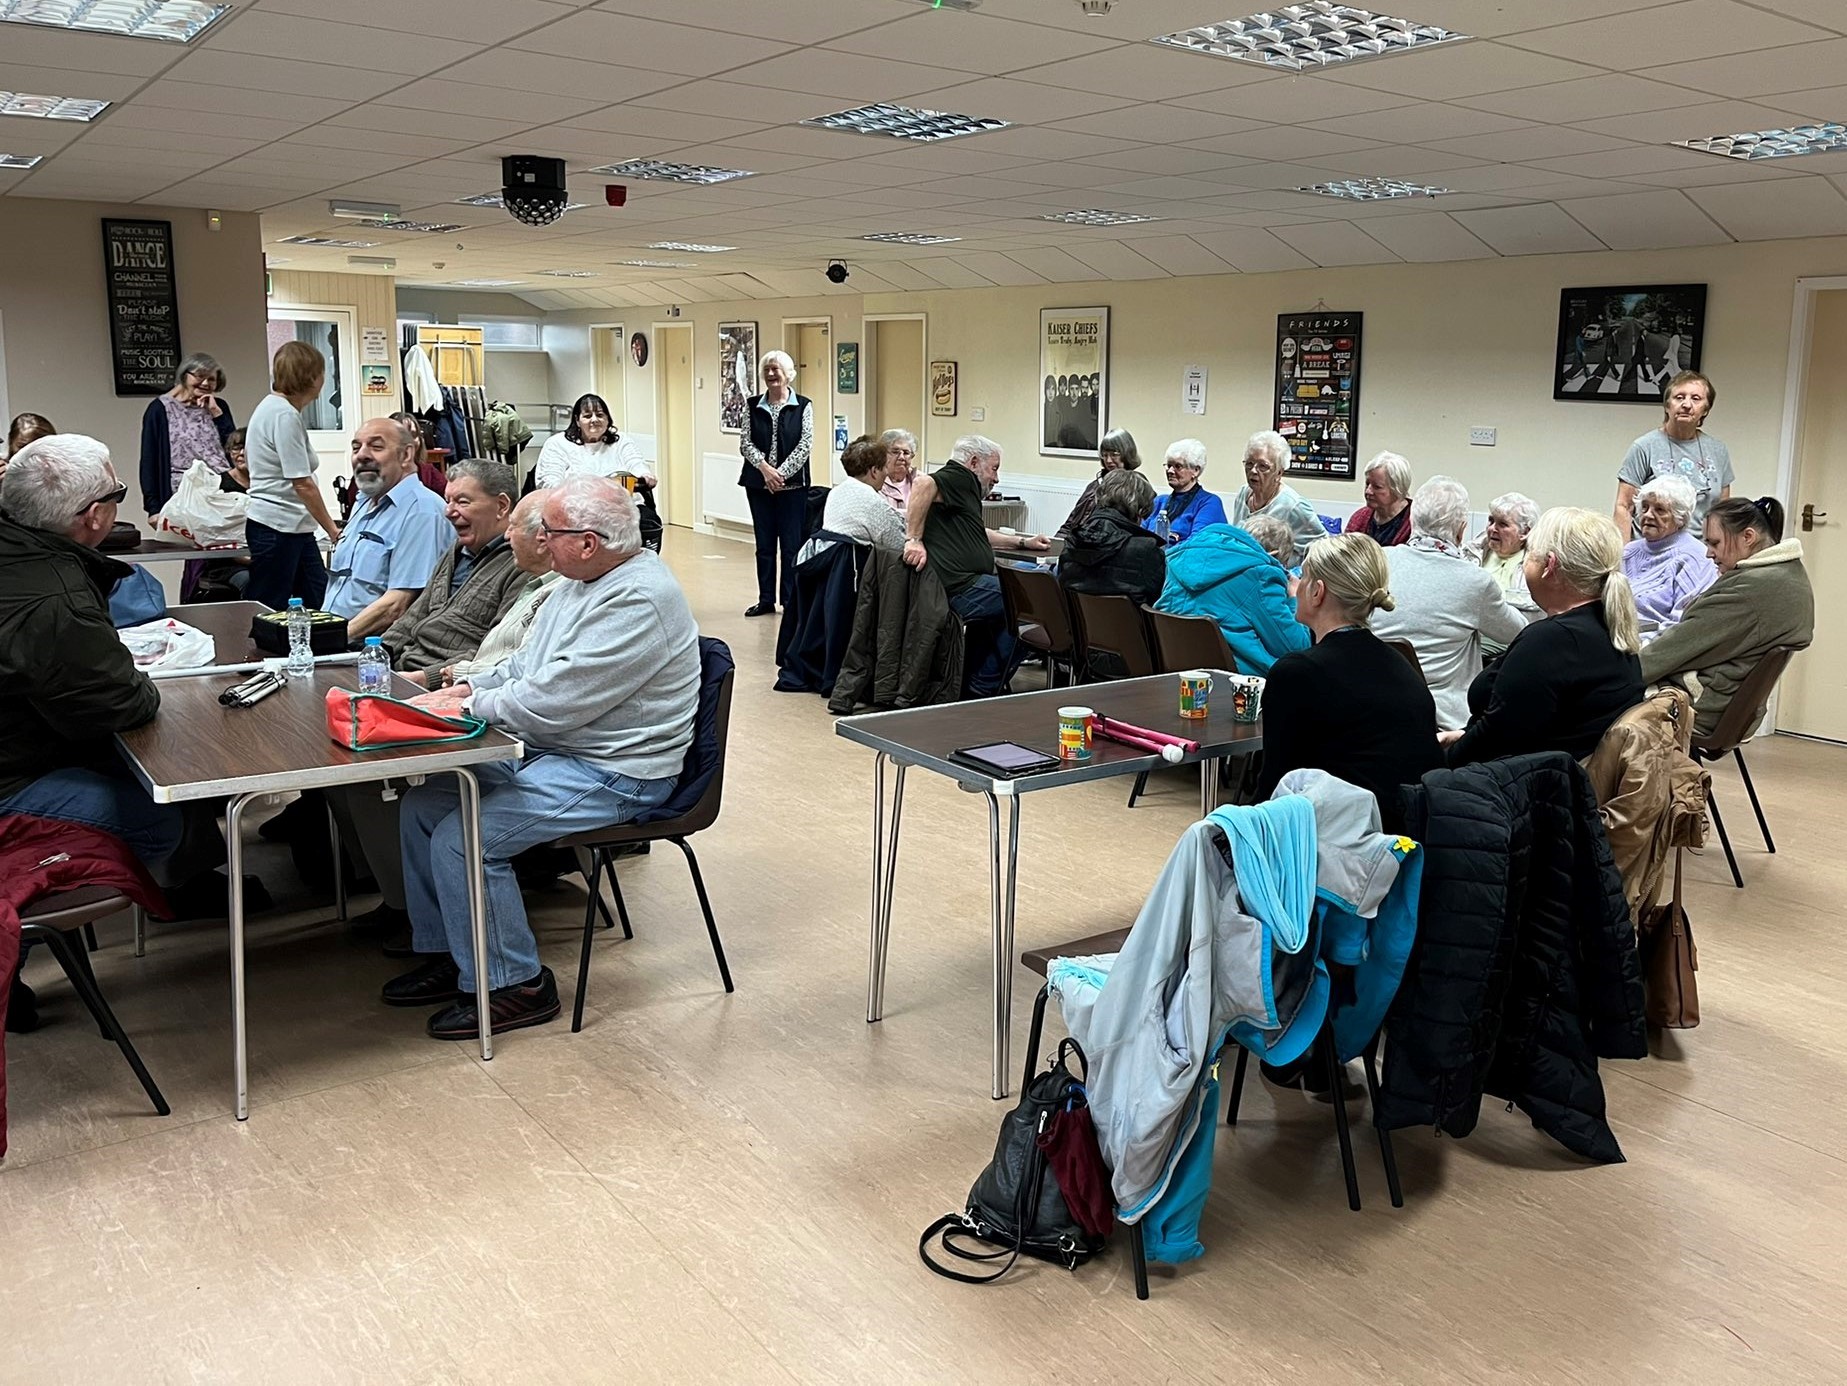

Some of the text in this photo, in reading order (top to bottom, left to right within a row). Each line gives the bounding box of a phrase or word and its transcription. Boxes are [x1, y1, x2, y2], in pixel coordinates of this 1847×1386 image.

[112, 241, 166, 268] DANCE
[114, 272, 154, 282] CHANNEL
[117, 304, 145, 314] Don't
[1048, 322, 1098, 335] KAISER CHIEFS
[1289, 319, 1349, 329] FRIENDS
[134, 332, 157, 342] PLAY!
[138, 356, 174, 368] SOUL
